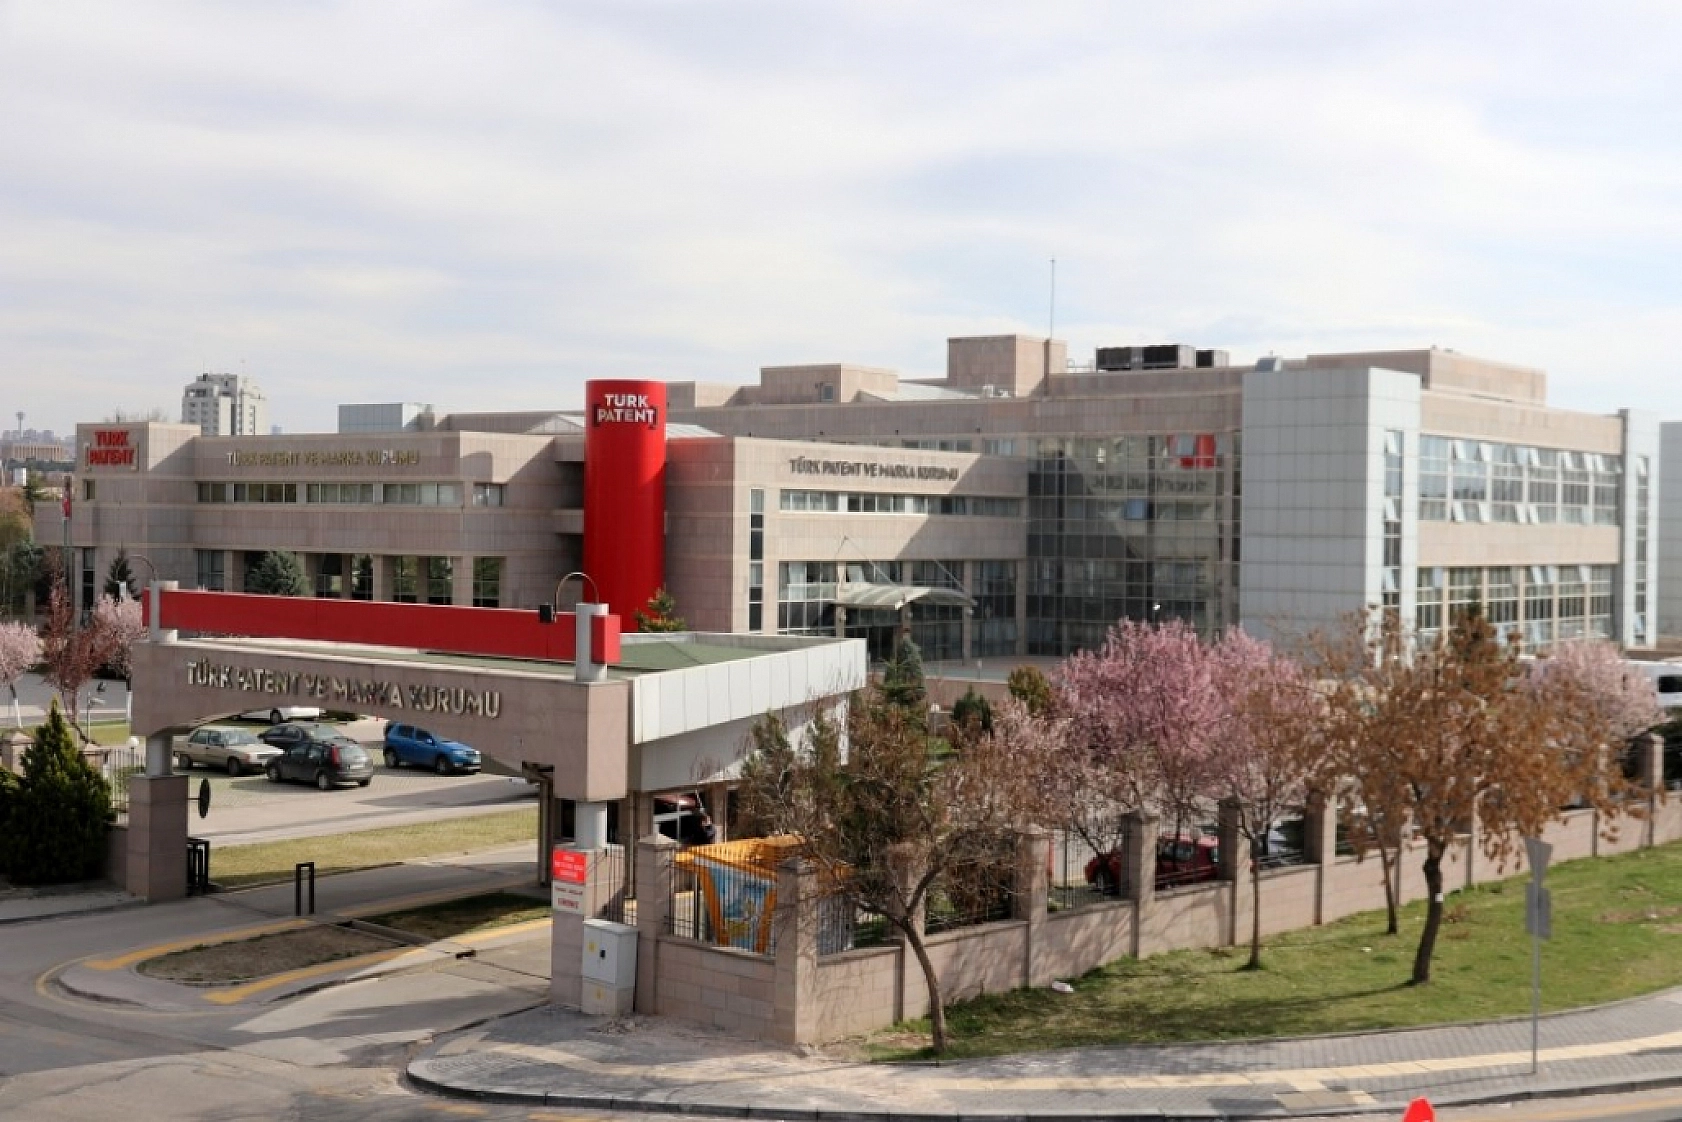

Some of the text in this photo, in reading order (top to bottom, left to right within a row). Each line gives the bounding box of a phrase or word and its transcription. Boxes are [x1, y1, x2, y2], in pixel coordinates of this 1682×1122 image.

[597, 408, 655, 424] PATENT
[89, 449, 135, 466] PATENT
[260, 450, 299, 467] PATENT
[322, 450, 364, 467] MARKA
[789, 456, 821, 475] TÜRK
[822, 460, 862, 477] PATENT
[863, 463, 878, 478] VE
[186, 656, 502, 719] TÜRK PATENT VE MARKA KURUMU
